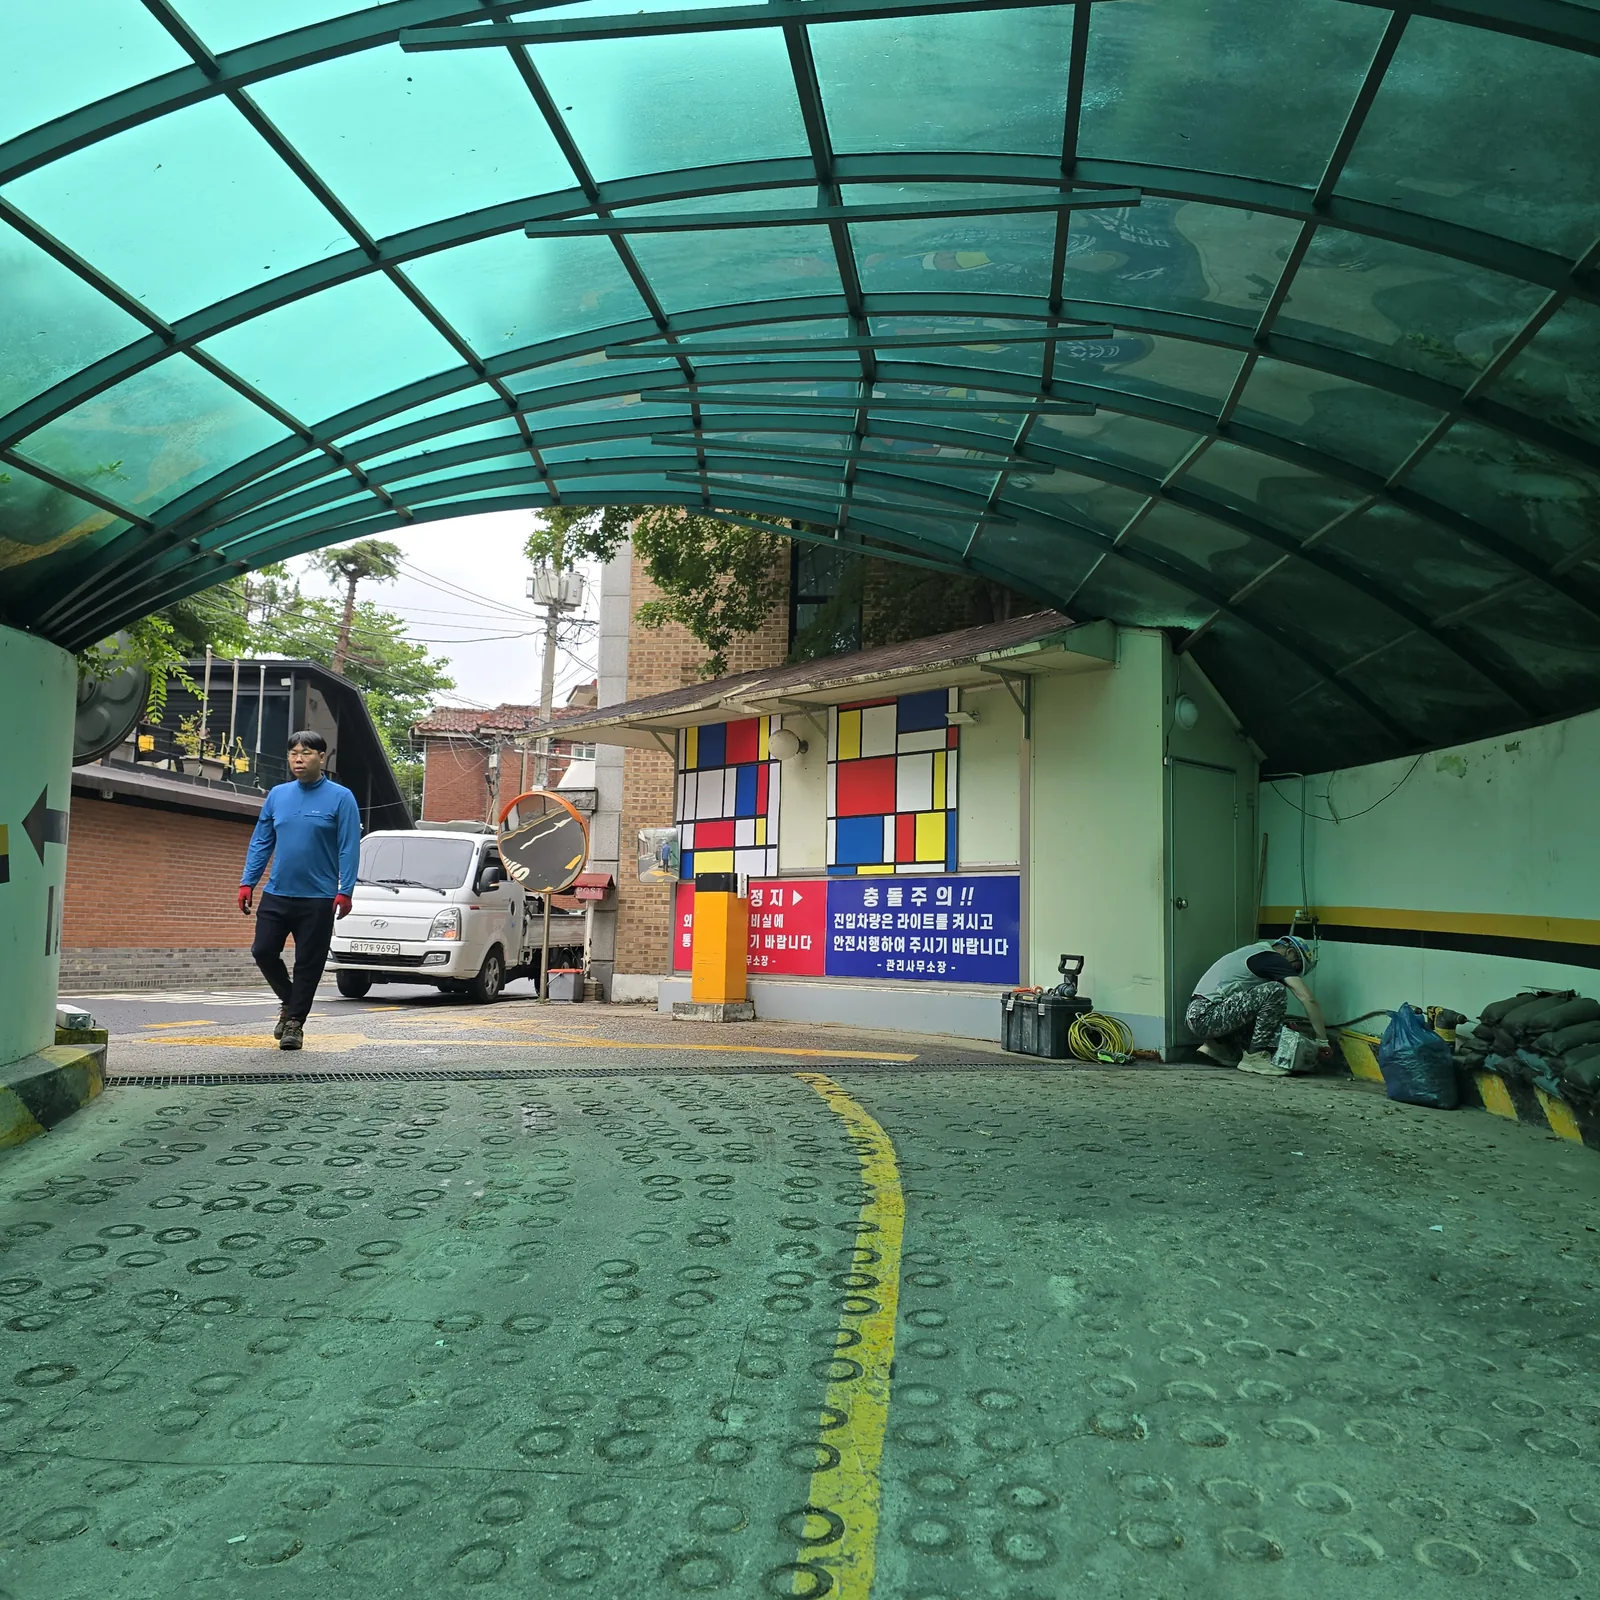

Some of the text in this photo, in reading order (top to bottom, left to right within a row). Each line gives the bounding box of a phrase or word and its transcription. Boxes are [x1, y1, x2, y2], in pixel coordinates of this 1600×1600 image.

[576, 886, 602, 895] POST
[833, 913, 993, 930] 진입차량은 라이트를 켜시고
[376, 944, 396, 953] 9695
[764, 934, 812, 950] 바랍니다
[833, 935, 1009, 955] 안전서행하여 주시기 바랍니다
[886, 959, 947, 973] 관리사무소장
